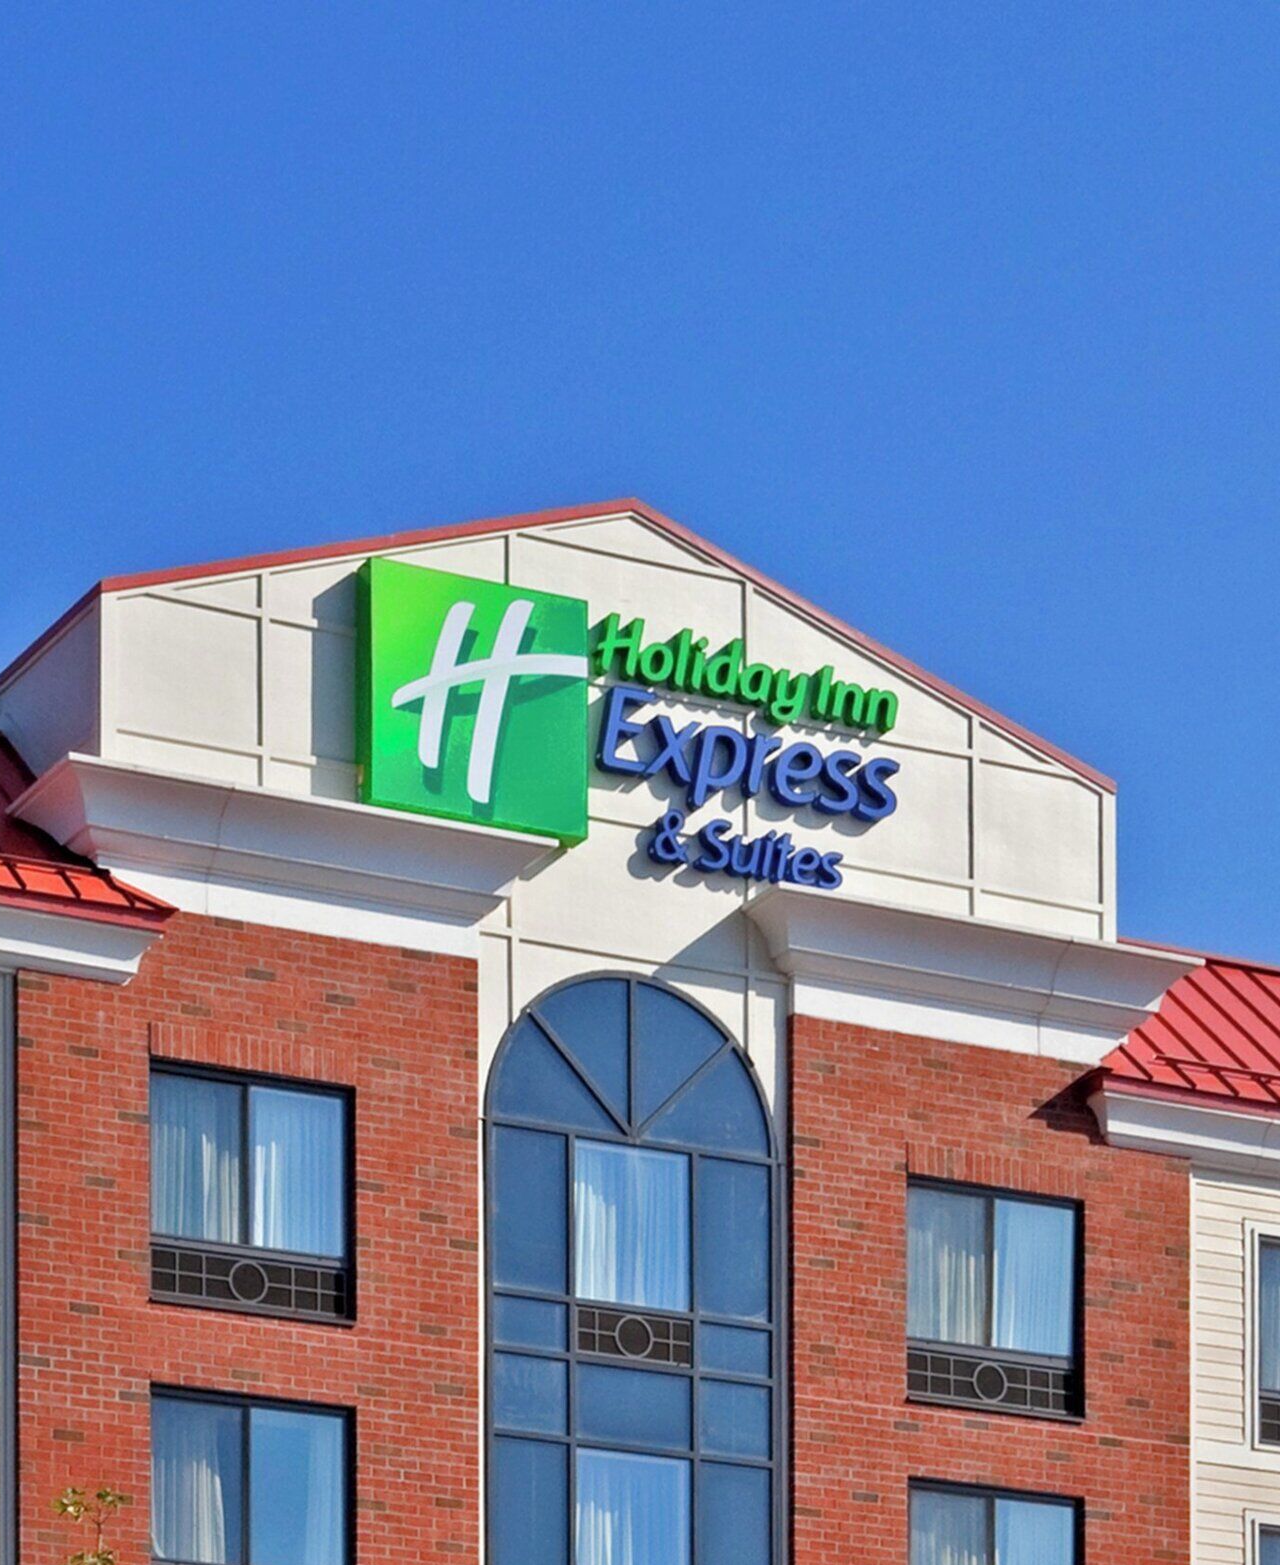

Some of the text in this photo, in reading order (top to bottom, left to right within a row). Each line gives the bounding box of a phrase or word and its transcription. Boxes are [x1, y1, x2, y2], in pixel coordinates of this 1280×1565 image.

[593, 612, 898, 732] Holiday Inn
[595, 685, 901, 822] Express
[648, 808, 844, 890] & Suites
